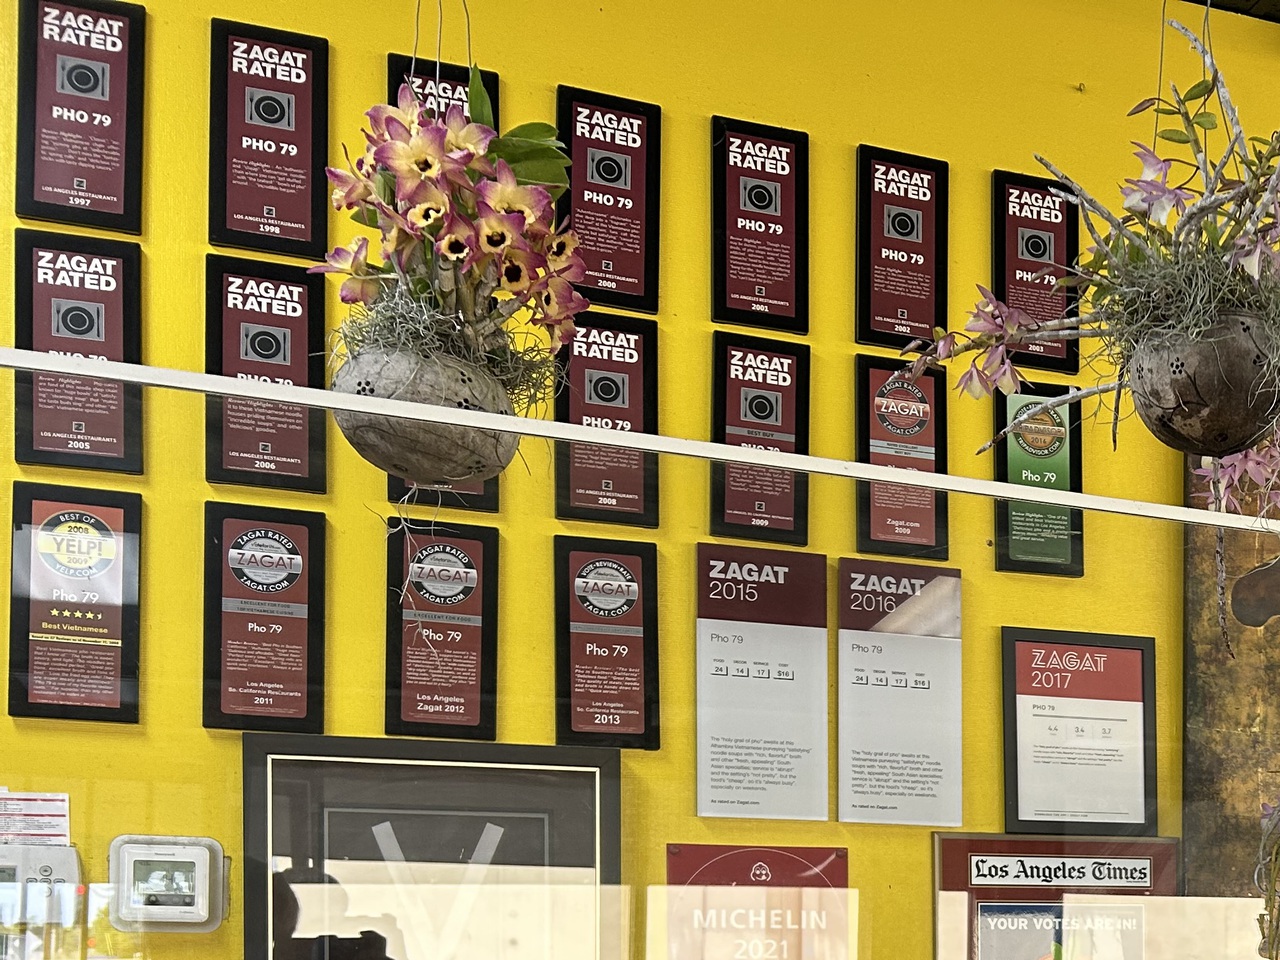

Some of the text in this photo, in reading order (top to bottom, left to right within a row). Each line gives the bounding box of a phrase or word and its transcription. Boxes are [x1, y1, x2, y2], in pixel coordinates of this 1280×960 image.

[43, 7, 123, 37] ZAGAT
[43, 23, 122, 52] RATED
[232, 41, 307, 68] ZAGAT
[232, 57, 307, 84] RATED
[52, 106, 112, 127] PHO 79
[576, 107, 642, 133] ZAGAT
[576, 122, 642, 148] RATED
[241, 136, 298, 157] PHO 79
[729, 137, 790, 162] ZAGAT
[729, 152, 790, 176] RATED
[875, 164, 931, 189] ZAGAT
[55, 186, 117, 201] ANGELES RESTAURANTS
[874, 178, 931, 201] RATED
[68, 197, 91, 207] 1997
[584, 190, 633, 210] PHO 79
[1009, 189, 1063, 210] ZAGAT
[1009, 202, 1063, 223] RATED
[246, 215, 305, 229] ANGELES RESTAURANTS
[259, 224, 280, 234] 1998
[737, 218, 784, 235] PHO 79
[37, 250, 117, 275] ZAGAT
[881, 248, 924, 265] PHO 79
[37, 268, 117, 292] RATED
[597, 279, 617, 289] 2000
[1043, 273, 1056, 286] 79
[228, 277, 303, 301] ZAGAT
[227, 294, 303, 318] RATED
[751, 303, 769, 312] 2001
[894, 324, 910, 333] 2002
[573, 327, 638, 349] ZAGAT
[573, 341, 638, 364] RATED
[1028, 343, 1044, 352] 2003
[730, 350, 791, 374] ZAGAT
[730, 364, 791, 387] RATED
[882, 382, 922, 397] ZAGAT RATED
[880, 400, 925, 417] ZAGAT
[582, 416, 632, 431] PHO 79
[884, 421, 920, 435] ZAGAT.COM
[52, 432, 117, 443] ANGELES RESTAURANTS
[67, 440, 90, 450] 2005
[240, 452, 301, 464] ANGELES RESTAURANTS
[254, 460, 276, 470] 2006
[1022, 470, 1057, 483] Pho 79
[598, 497, 617, 505] 2008
[60, 513, 96, 524] BEST OF
[751, 518, 769, 527] 2009
[886, 519, 920, 528] Zagat.com
[67, 526, 89, 534] 2008
[895, 526, 911, 535] 2009
[53, 537, 103, 557] YELP!
[237, 530, 293, 549] ZAGAT RATED
[67, 556, 88, 565] 2009
[237, 552, 295, 570] ZAGAT
[419, 545, 469, 563] ZAGAT RATED
[55, 563, 98, 577] YELP.COM
[417, 566, 470, 583] ZAGAT
[709, 560, 789, 584] ZAGAT
[240, 576, 290, 592] ZAGAT.COM
[582, 581, 632, 596] ZAGAT
[709, 580, 758, 601] 2015
[850, 573, 925, 596] ZAGAT
[52, 589, 99, 603] Pho 79
[420, 589, 465, 604] ZAGAT.COM
[850, 592, 896, 613] 2016
[584, 601, 629, 617] ZAGAT.COM
[62, 623, 109, 634] Vietnamese
[248, 622, 283, 634] Pho 79
[423, 629, 462, 642] Pho 79
[711, 633, 744, 644] Pho 79
[586, 643, 629, 658] Pho 79
[851, 644, 883, 654] Pho 79
[1031, 649, 1107, 672] ZAGAT
[258, 682, 284, 690] Angeles
[1032, 671, 1072, 689] 2017
[267, 689, 302, 697] Restaurants
[417, 693, 465, 704] Los Angeles
[254, 697, 273, 705] 2011
[417, 703, 465, 714] Zagat 2012
[594, 714, 621, 724] 2013
[1102, 727, 1112, 735] 3.7
[975, 859, 1147, 884] Los Angeles Times
[693, 909, 827, 930] MICHELIN
[988, 918, 1137, 930] YOUR VOTES ARE IN!
[734, 940, 788, 960] 2021
